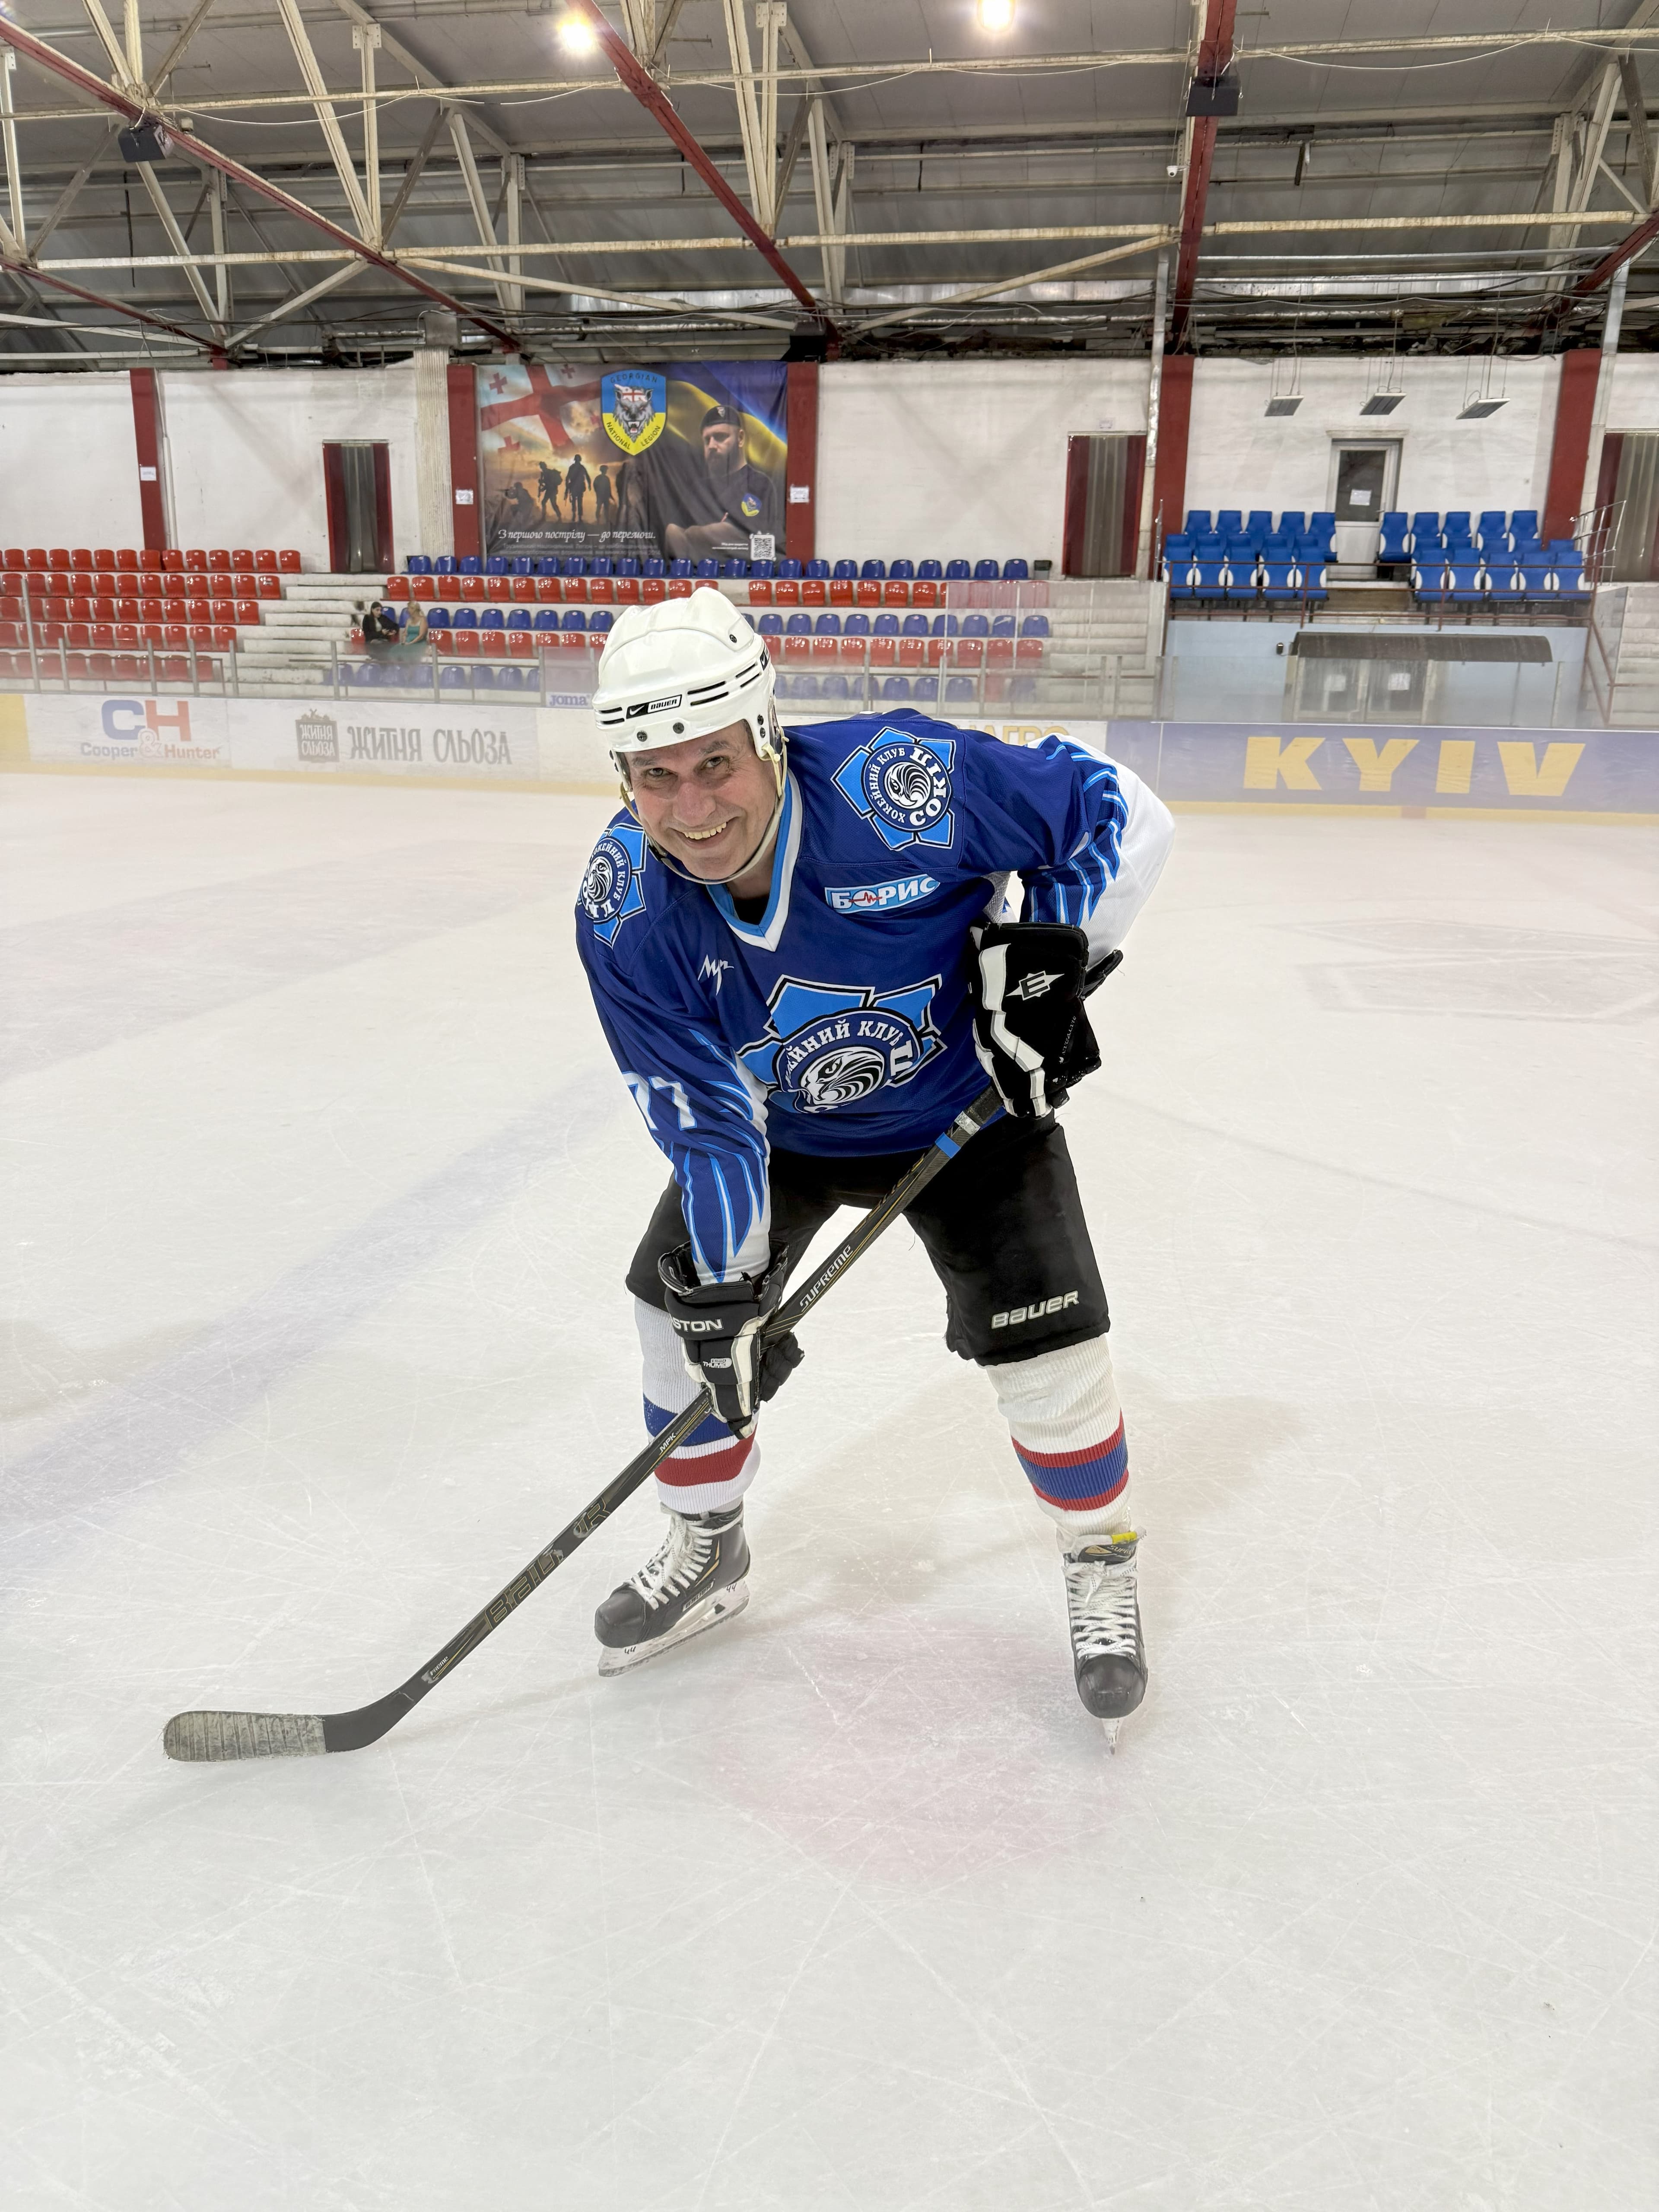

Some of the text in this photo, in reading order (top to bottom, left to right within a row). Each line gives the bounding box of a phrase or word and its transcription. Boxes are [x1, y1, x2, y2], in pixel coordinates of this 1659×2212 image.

[610, 373, 658, 383] GEORGIAN
[606, 422, 631, 450] NATIONAL
[641, 426, 661, 447] LEGION
[498, 529, 507, 539] З
[508, 531, 543, 543] першого
[545, 529, 585, 543] пострілу
[599, 531, 611, 543] до
[102, 699, 192, 742] CH
[299, 724, 333, 740] ЖИТНЯ
[80, 742, 138, 760] Cooper
[164, 744, 220, 760] Hunter
[301, 741, 336, 756] СЛЬОЗА
[347, 725, 512, 765] ЖИТНЯ СЛЬОЗА
[1243, 736, 1586, 796] KYIV
[868, 747, 906, 823] ХОКЕЙНИЙ КЛУБ
[909, 747, 947, 826] СОКІЛ
[591, 842, 627, 901] ОКЕЙНИЙ КЛУБ
[831, 878, 939, 909] БОРИС
[857, 1020, 904, 1046] КЛУБ
[622, 1071, 697, 1131] 77
[672, 1317, 724, 1332] STON
[659, 1432, 677, 1456] MPK
[485, 1496, 610, 1630] BAUR
[726, 1583, 736, 1592] 44
[624, 1646, 636, 1655] 44
[429, 1656, 449, 1676] PREME
